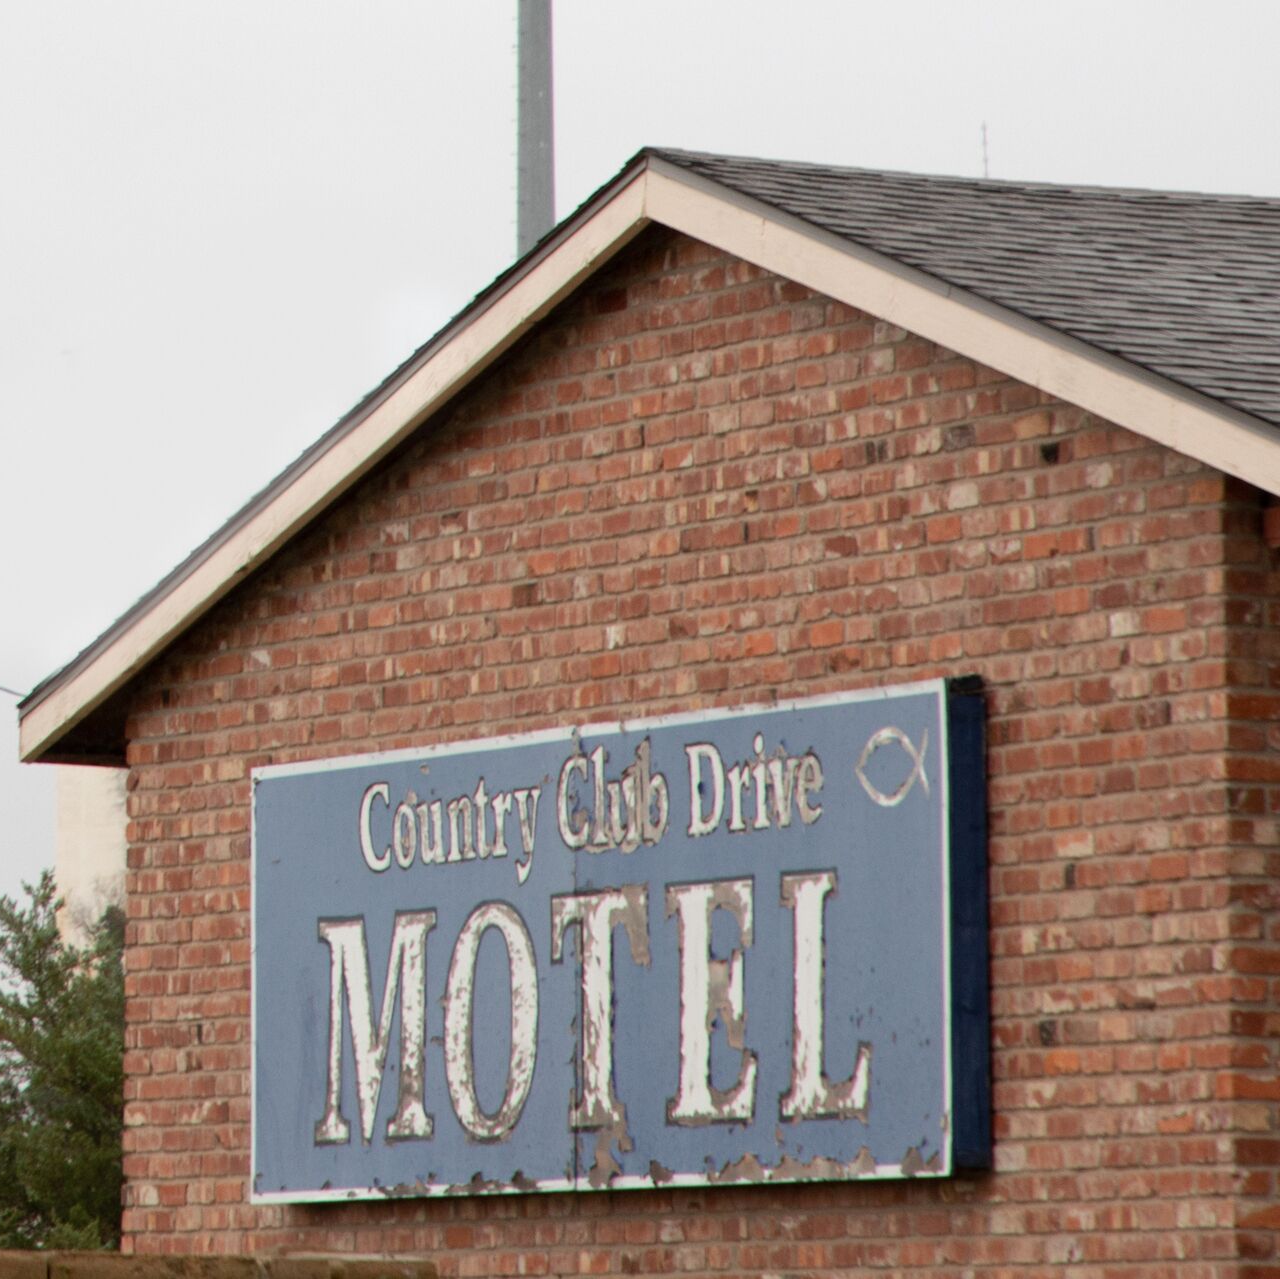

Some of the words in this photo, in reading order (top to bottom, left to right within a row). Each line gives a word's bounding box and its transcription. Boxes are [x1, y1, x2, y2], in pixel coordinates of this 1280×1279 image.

[358, 776, 542, 884] Country
[556, 738, 670, 854] Club
[685, 733, 825, 839] Drive
[314, 868, 873, 1147] MOTEL
